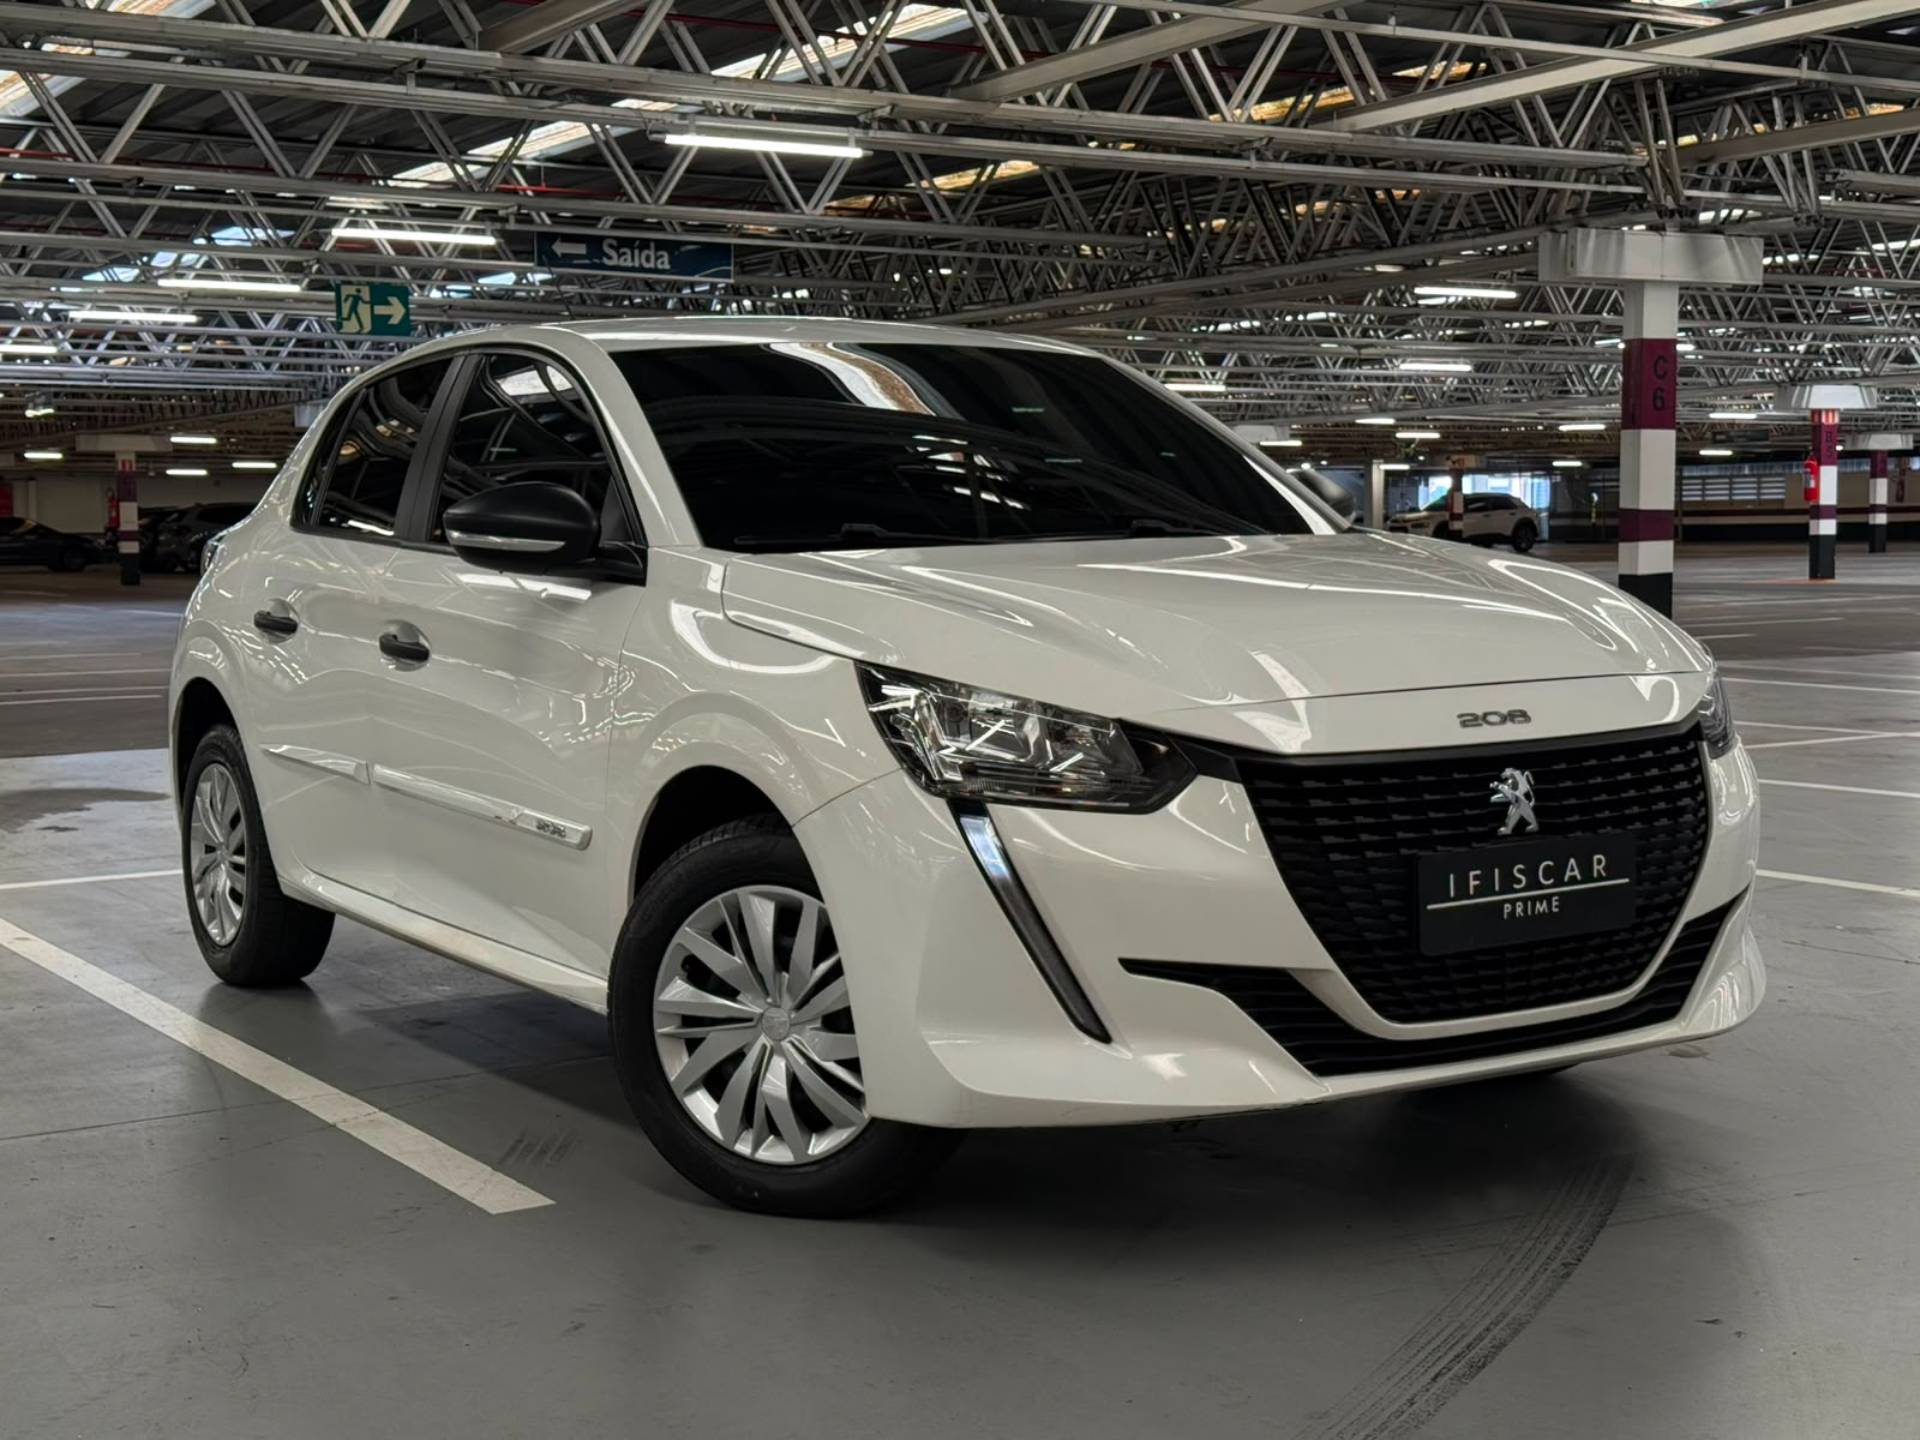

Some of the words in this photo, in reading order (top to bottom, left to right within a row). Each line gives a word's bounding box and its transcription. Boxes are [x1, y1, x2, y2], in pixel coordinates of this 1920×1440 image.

[602, 238, 671, 270] Saída
[1457, 709, 1532, 728] 208
[1449, 854, 1607, 898] IFISCAR
[1503, 896, 1560, 920] PRIME
